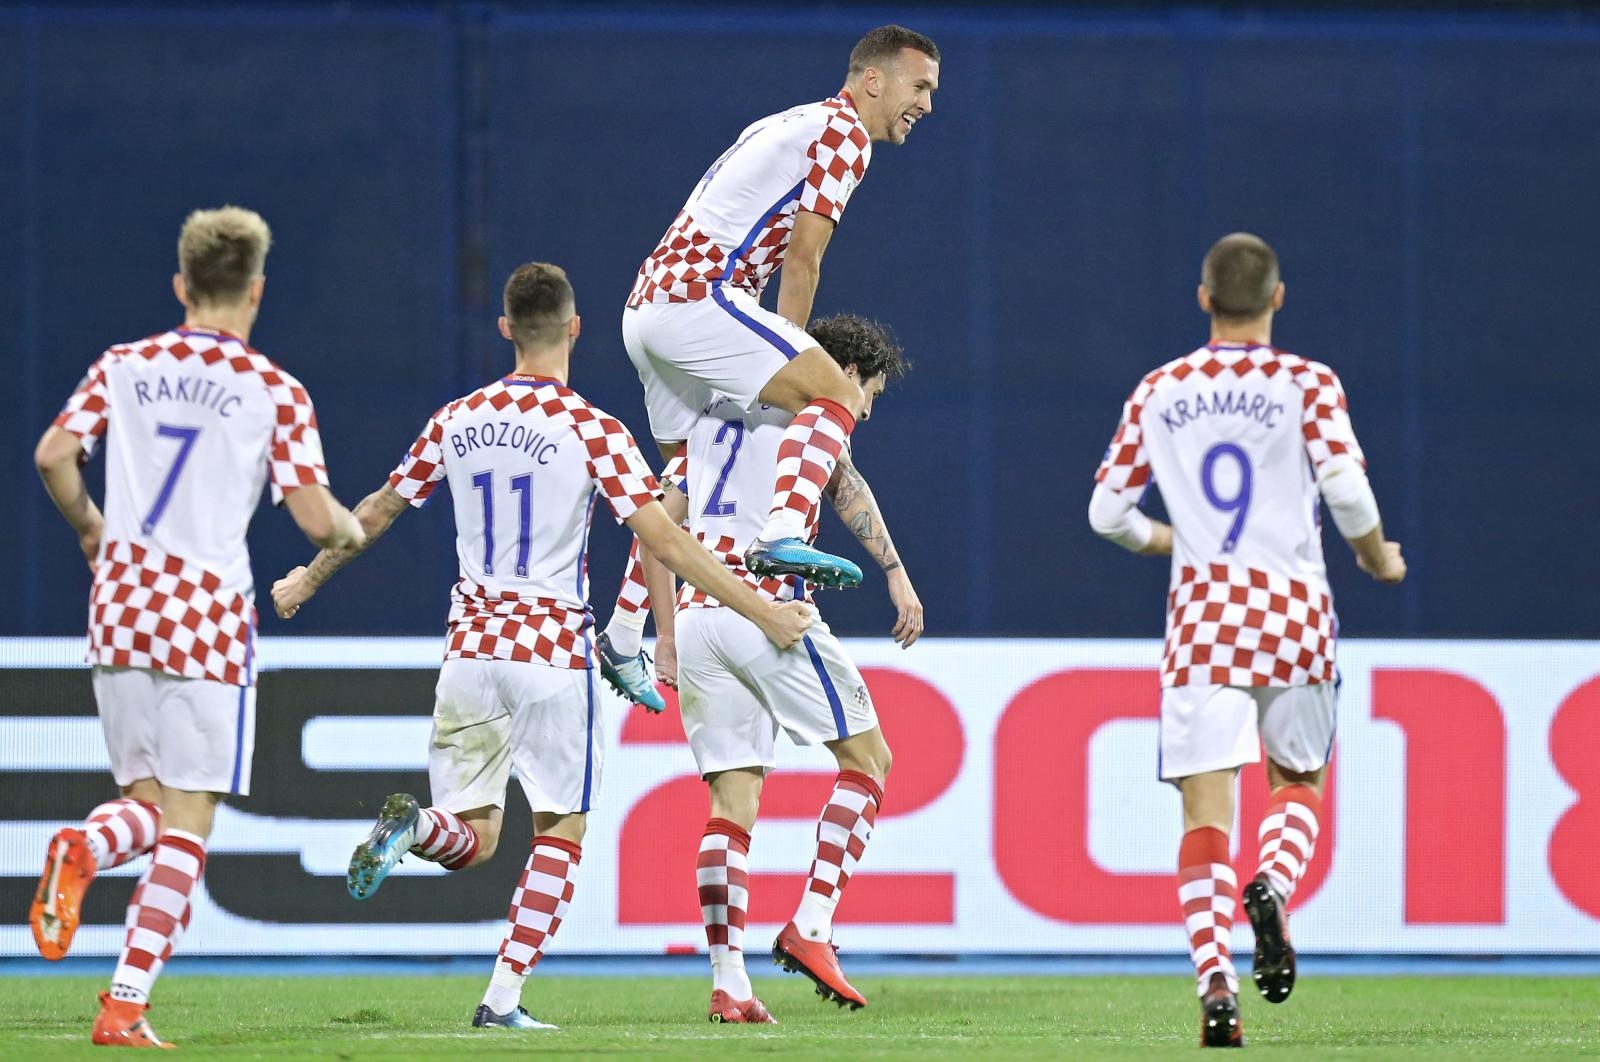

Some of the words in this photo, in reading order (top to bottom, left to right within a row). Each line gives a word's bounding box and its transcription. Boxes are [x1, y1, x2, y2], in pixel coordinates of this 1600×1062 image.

[141, 422, 204, 536] 7
[471, 468, 534, 578] 11
[701, 418, 745, 517] 2
[1201, 441, 1253, 555] 9
[618, 666, 1600, 925] 201
